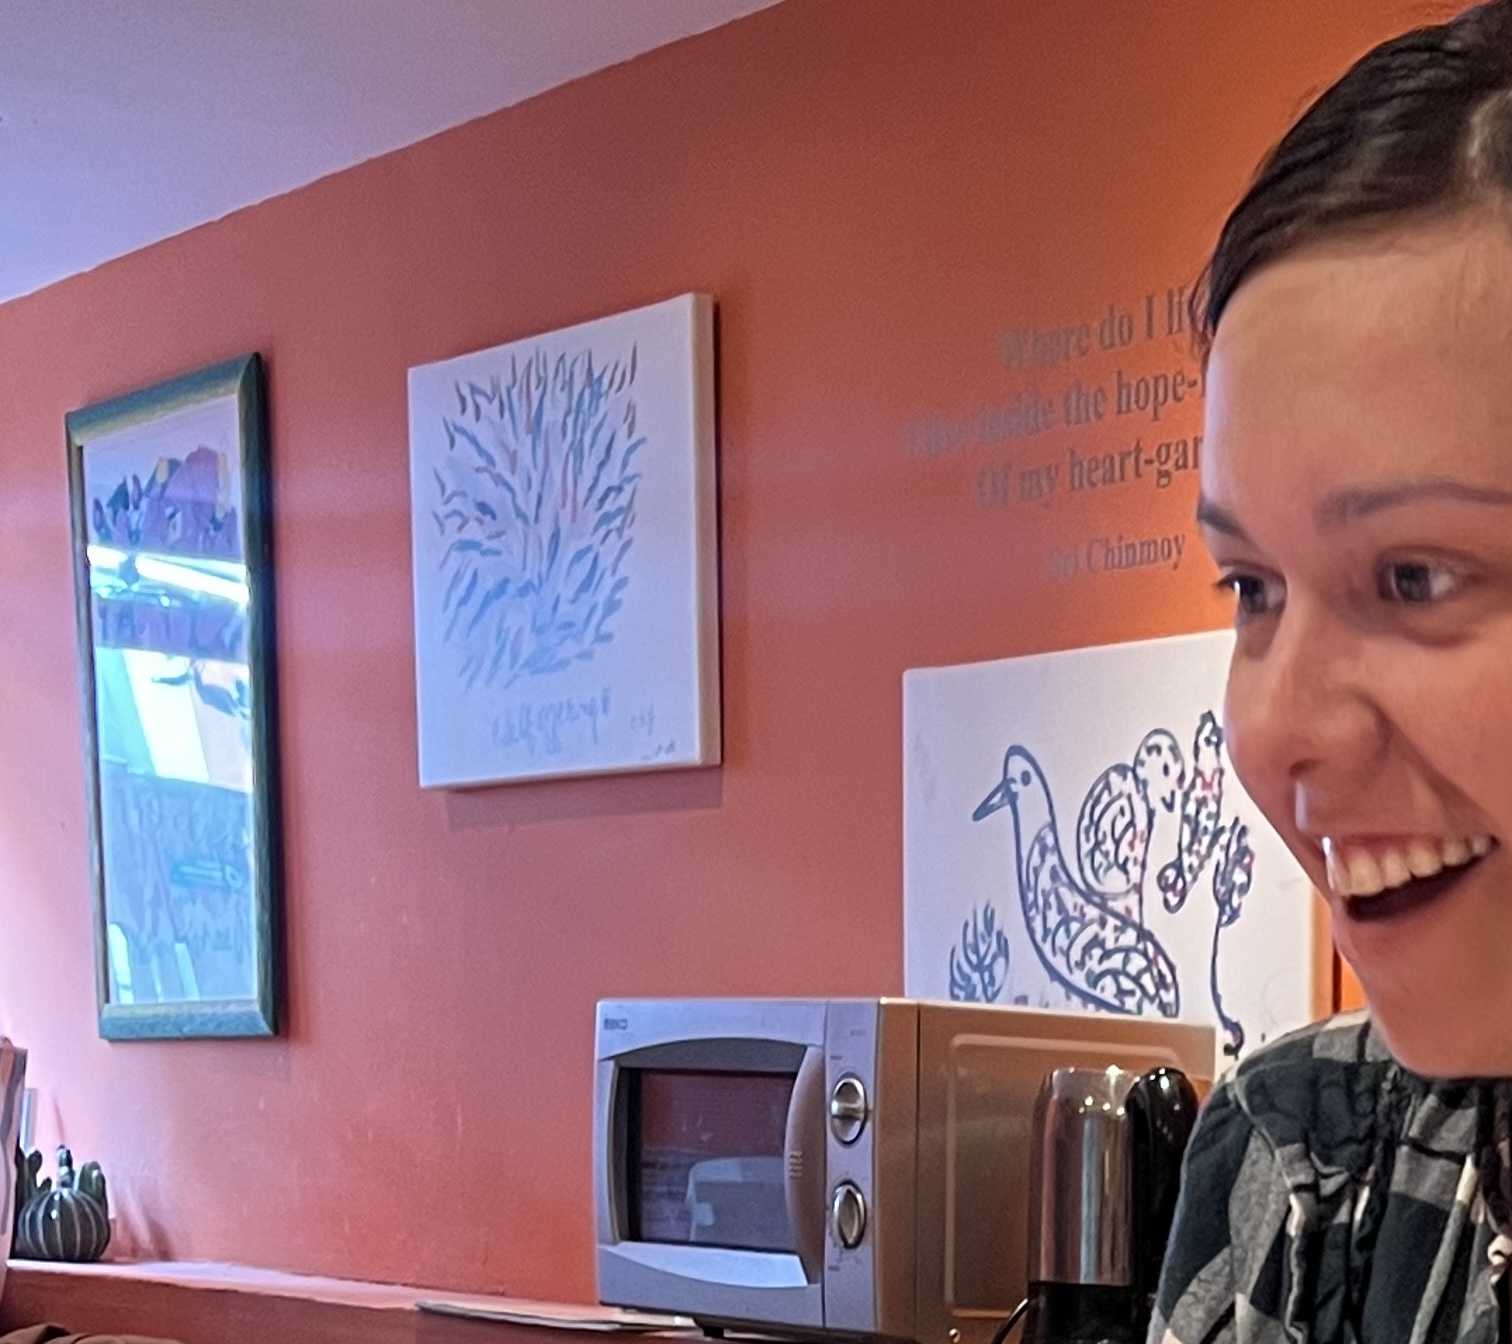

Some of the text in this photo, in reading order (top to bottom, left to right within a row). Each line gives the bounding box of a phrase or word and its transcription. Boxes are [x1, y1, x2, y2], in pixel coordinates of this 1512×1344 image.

[1099, 304, 1133, 350] do
[1145, 295, 1155, 340] I
[1062, 380, 1106, 427] the
[1116, 367, 1206, 423] hope-
[1066, 434, 1207, 492] heart-gar
[1086, 533, 1187, 576] Chinmoy
